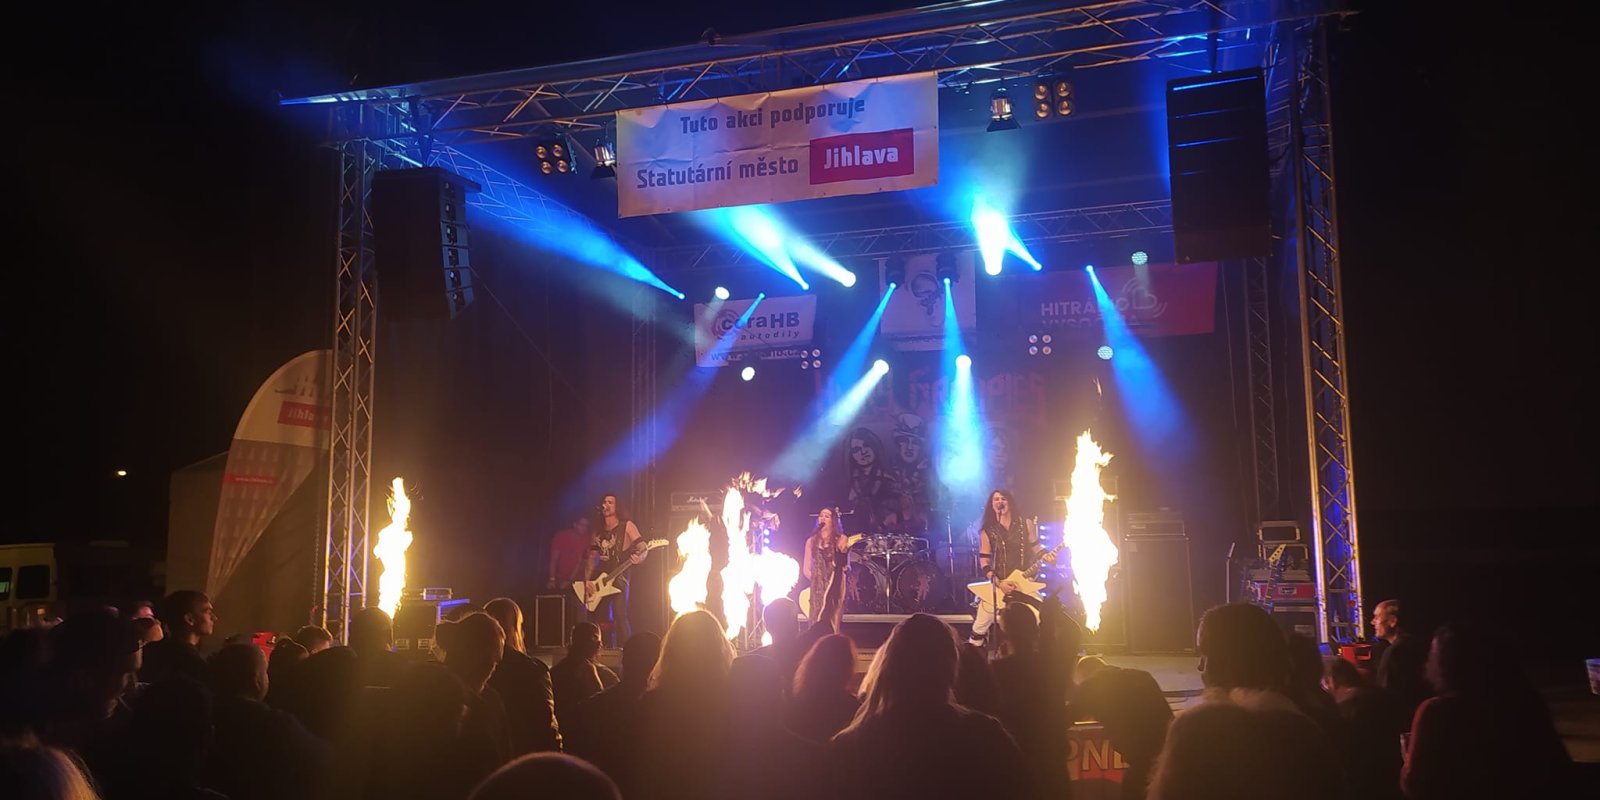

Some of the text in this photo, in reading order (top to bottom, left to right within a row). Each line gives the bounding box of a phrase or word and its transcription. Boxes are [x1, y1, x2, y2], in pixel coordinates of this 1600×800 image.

[680, 97, 866, 133] Tuto akci podporuje
[637, 156, 799, 189] Statutární město
[824, 146, 898, 168] Jihlava
